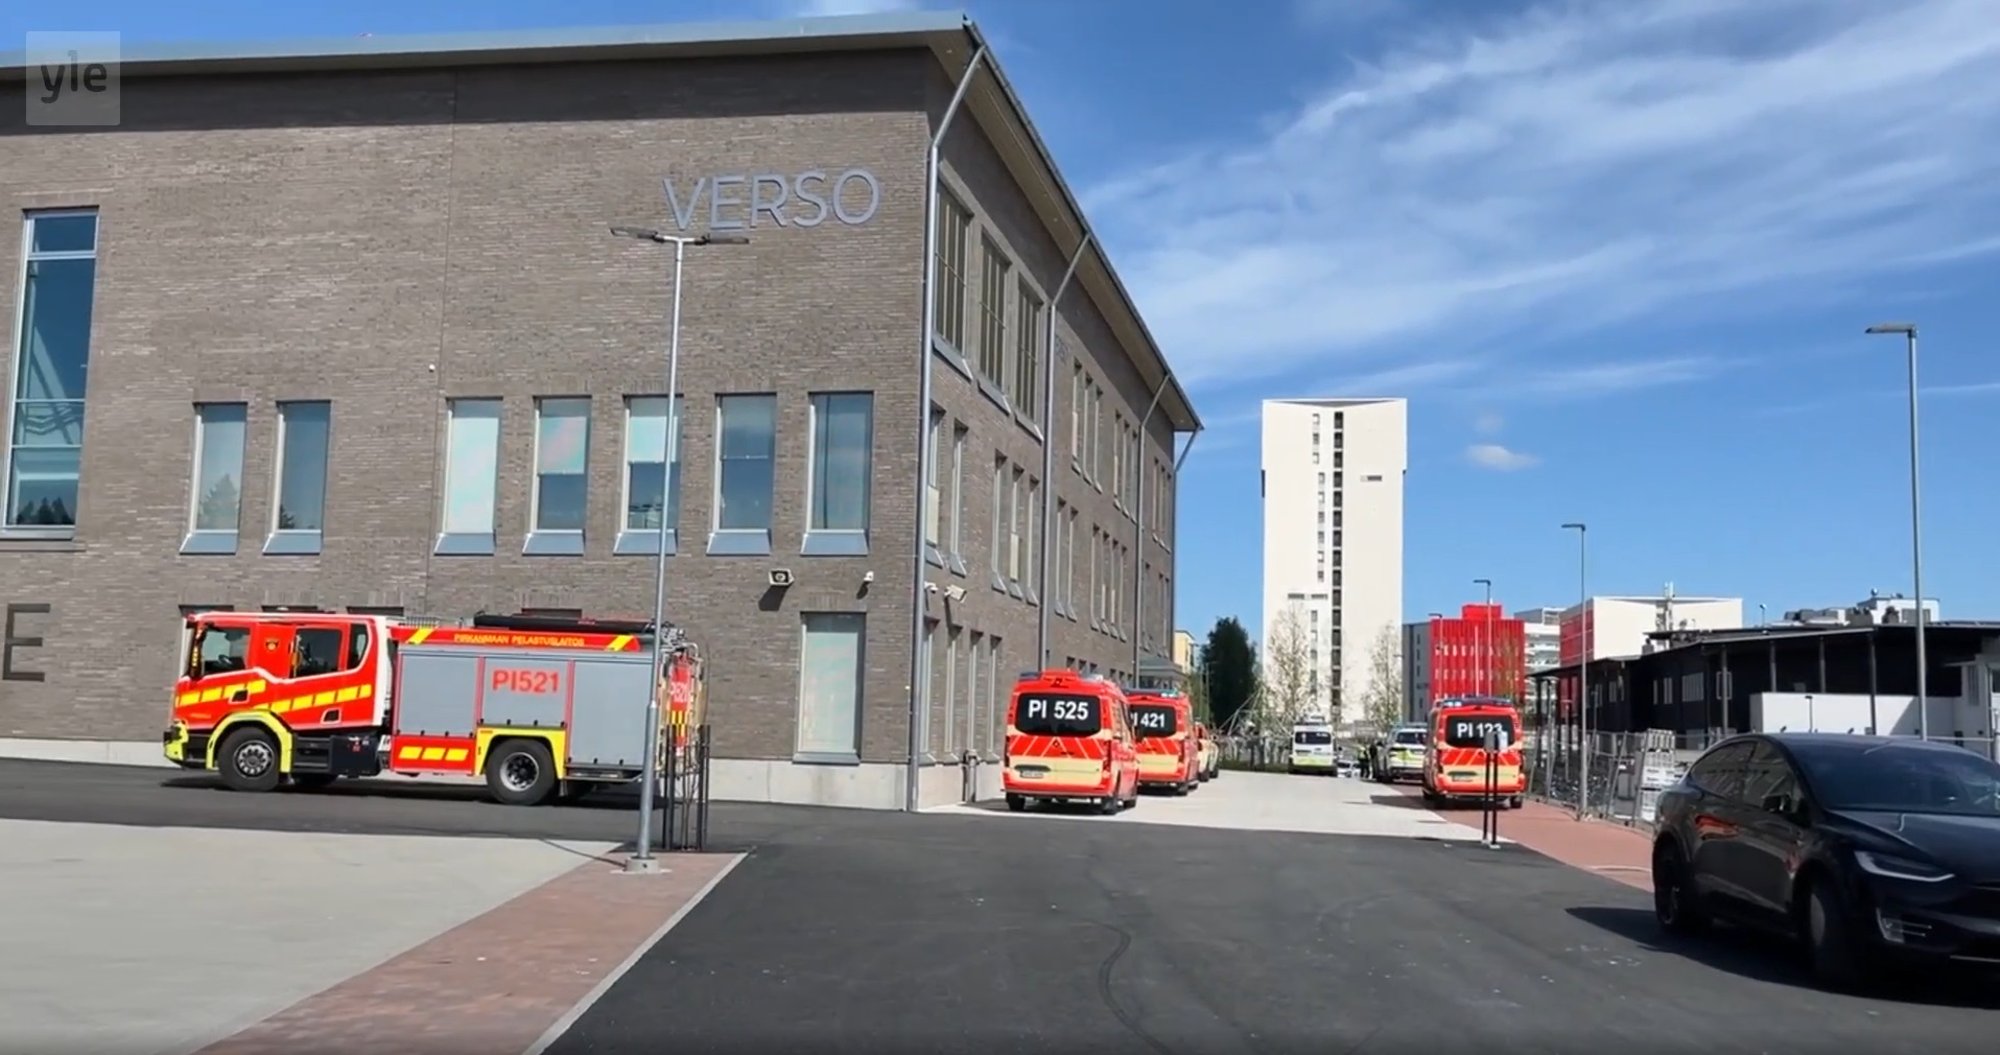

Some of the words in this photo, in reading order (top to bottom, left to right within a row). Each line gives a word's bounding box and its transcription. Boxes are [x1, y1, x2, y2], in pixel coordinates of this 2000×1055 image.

[662, 168, 880, 231] VERSO
[512, 635, 585, 646] PELASTUSLAITOS
[492, 669, 560, 693] PI521
[1028, 700, 1047, 719] PI
[1053, 701, 1089, 720] 525
[1140, 713, 1165, 728] 421
[1457, 722, 1473, 738] PI
